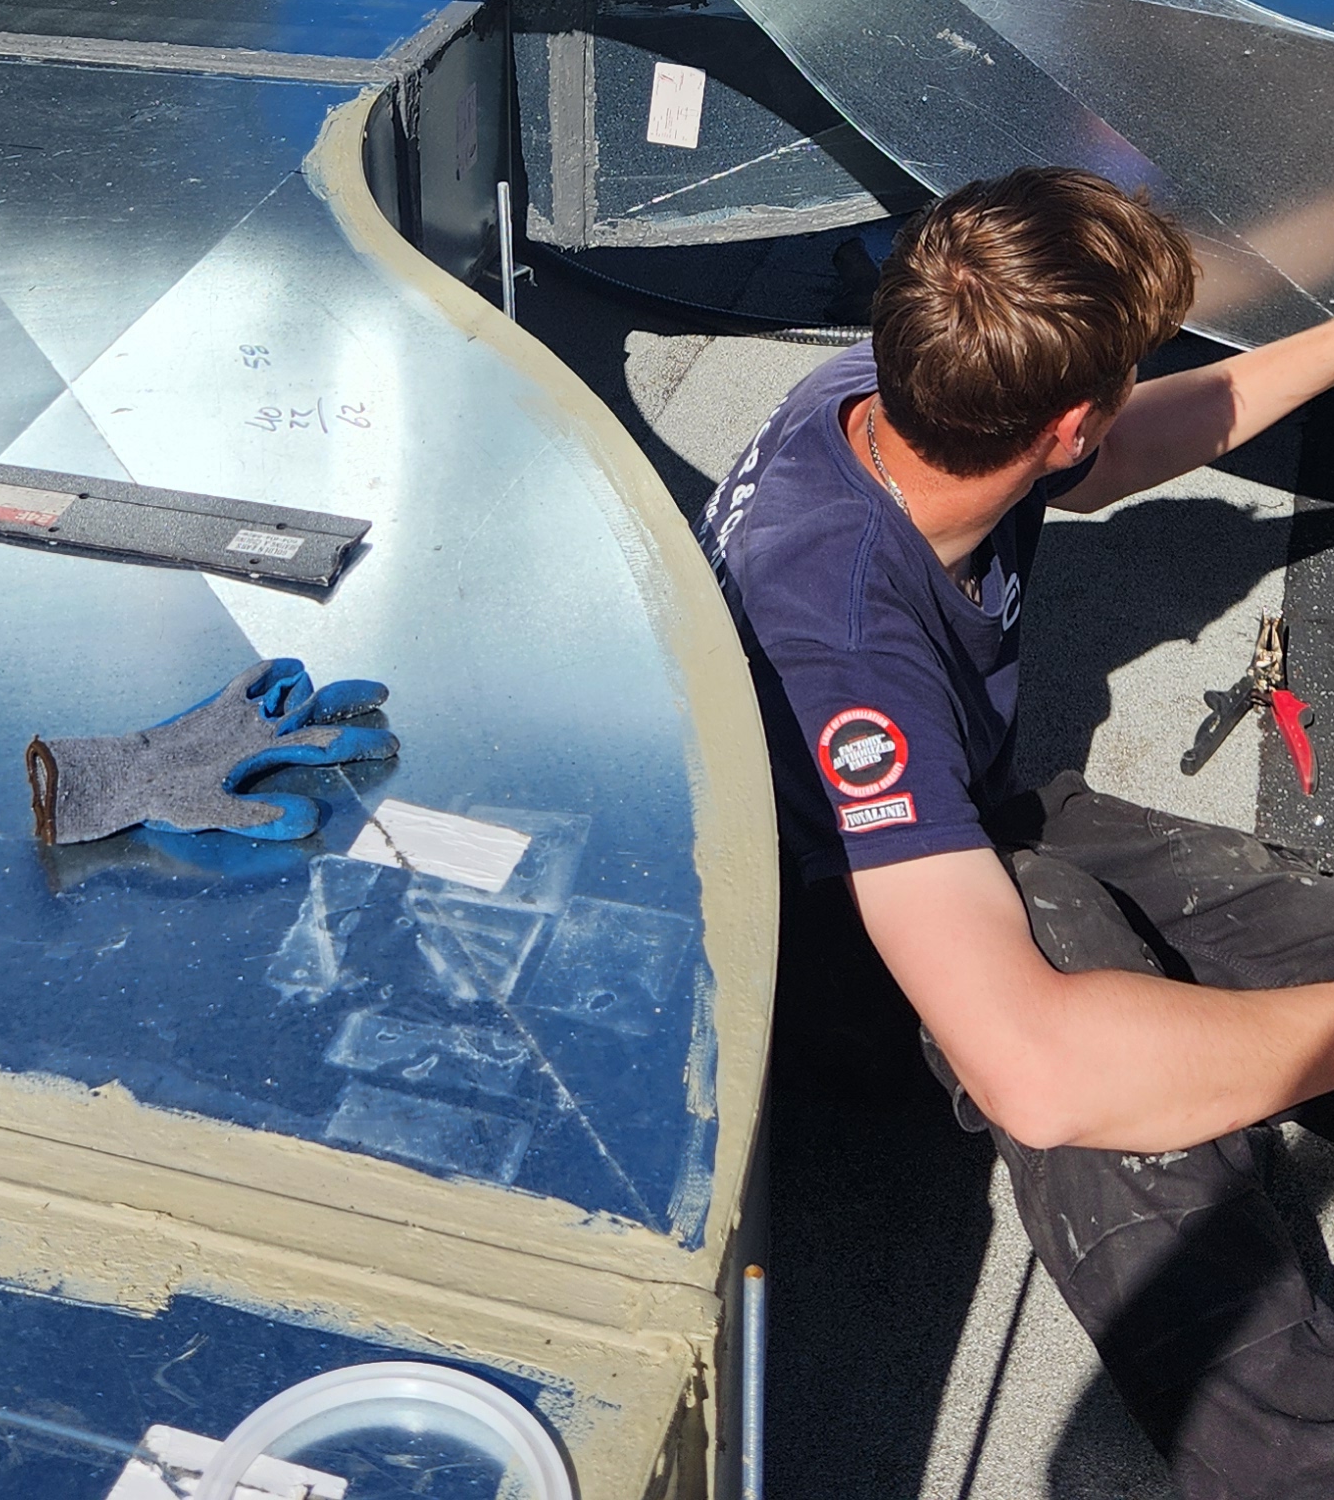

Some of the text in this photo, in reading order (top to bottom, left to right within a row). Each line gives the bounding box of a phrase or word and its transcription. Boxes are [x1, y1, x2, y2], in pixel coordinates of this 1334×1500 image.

[838, 735, 883, 757] FACTORY
[848, 753, 882, 771] PARTS
[847, 803, 907, 826] TOTALINE
